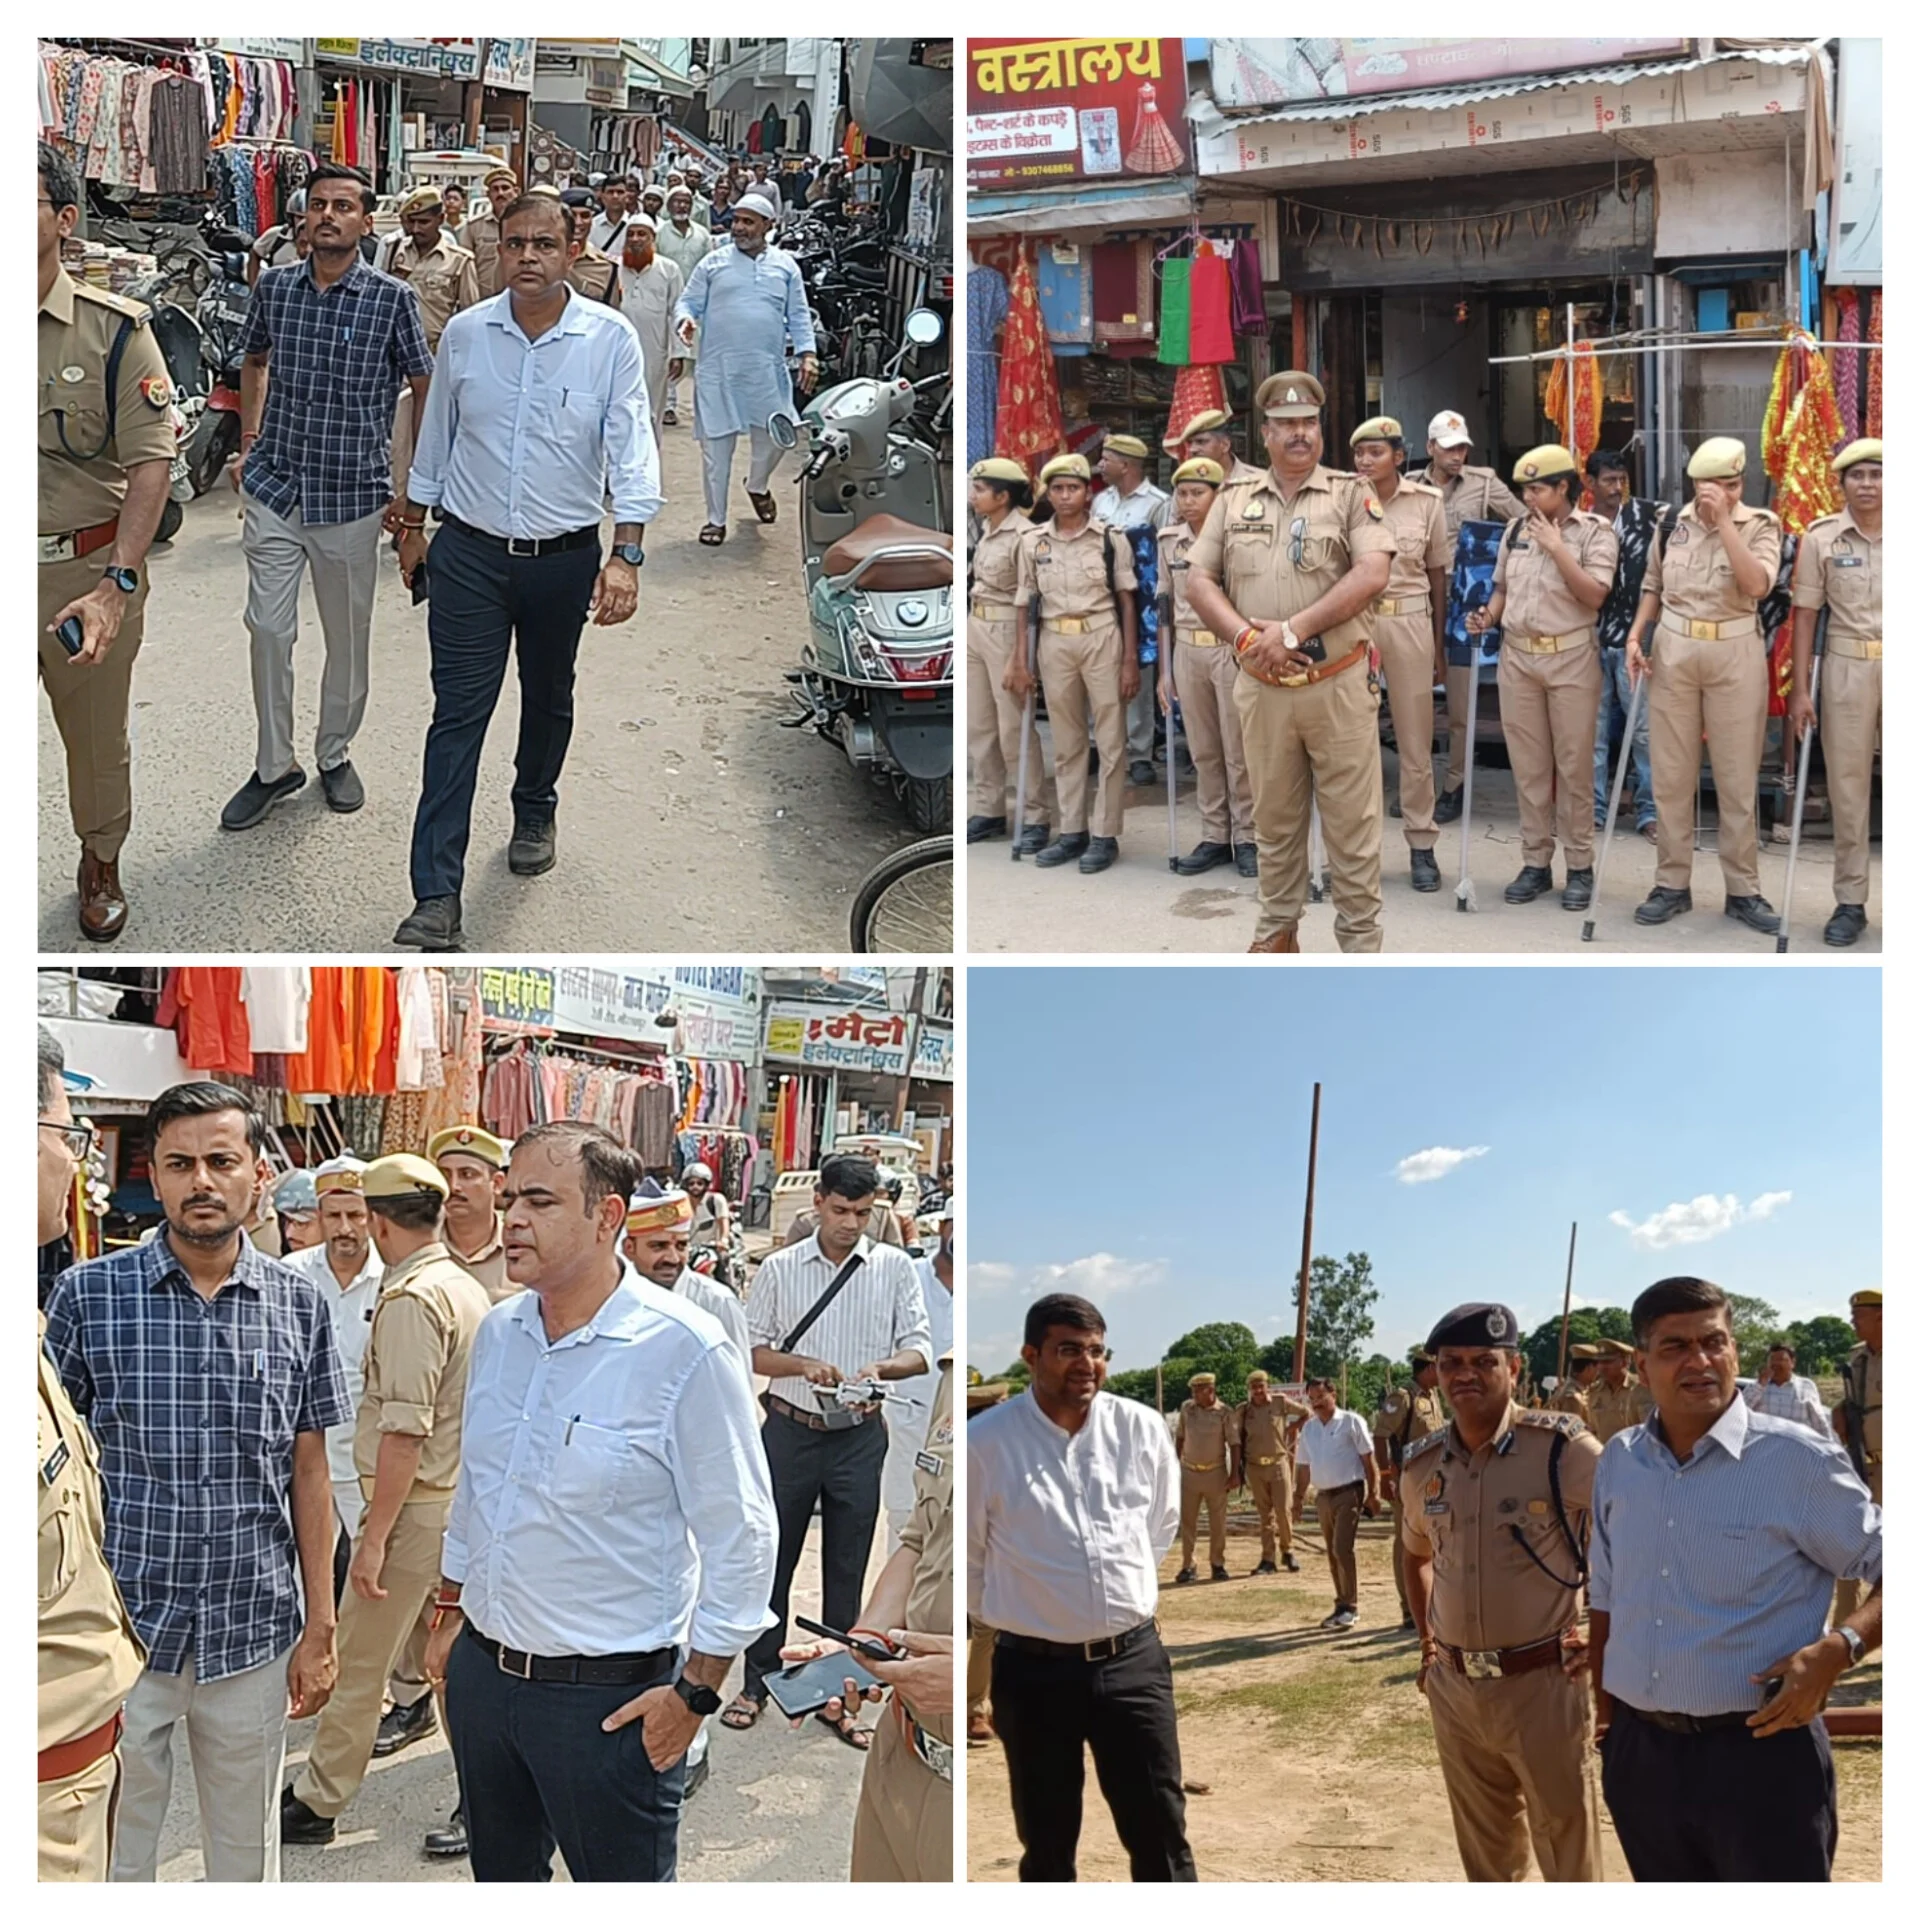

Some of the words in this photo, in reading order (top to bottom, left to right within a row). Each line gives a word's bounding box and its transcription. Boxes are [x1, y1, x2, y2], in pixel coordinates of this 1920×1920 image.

[972, 38, 1163, 94] वस्त्रालय
[1023, 112, 1035, 127] के
[1038, 109, 1067, 129] कपड़े
[1621, 104, 1631, 124] SGS
[1492, 120, 1501, 139] SGS
[1000, 134, 1013, 149] के
[1014, 132, 1052, 149] विक्रेता
[1373, 134, 1381, 153] SGS
[1260, 146, 1268, 164] SGS
